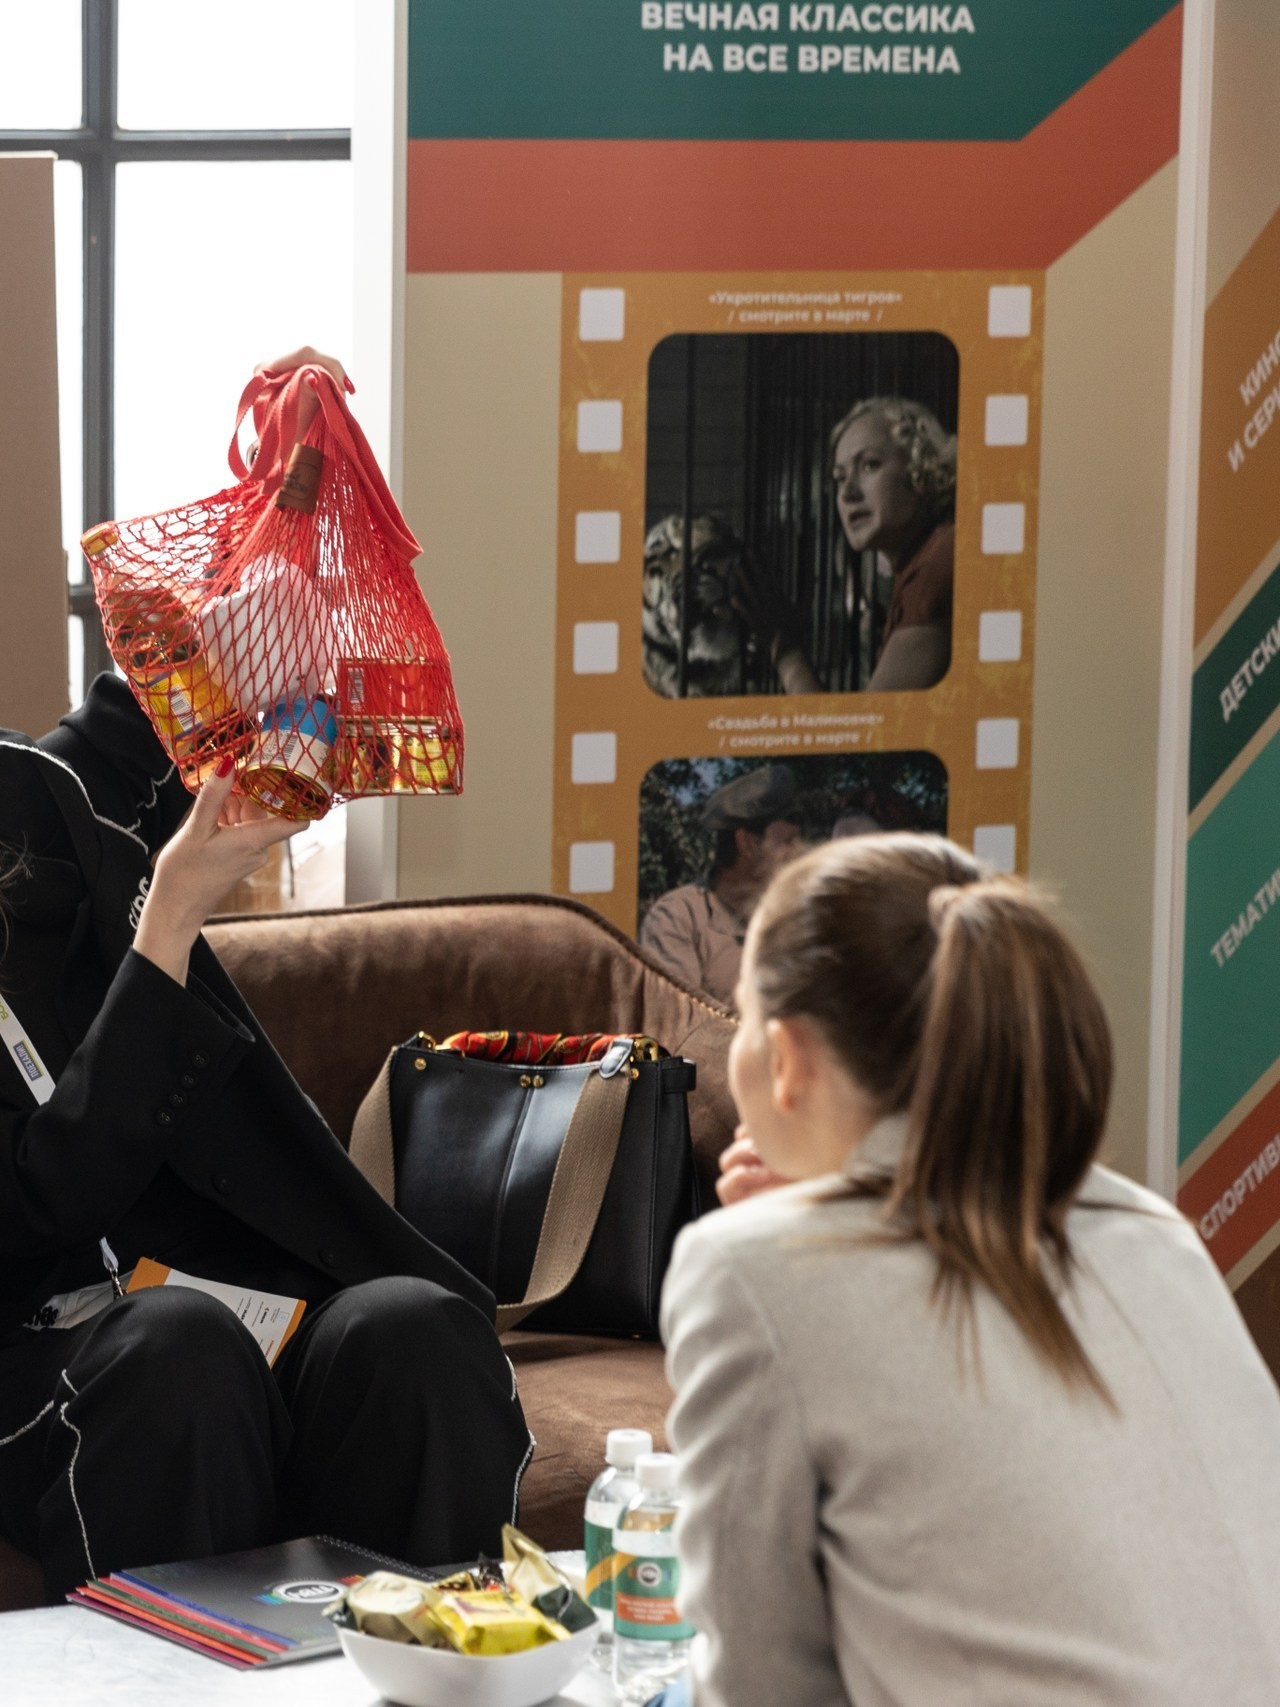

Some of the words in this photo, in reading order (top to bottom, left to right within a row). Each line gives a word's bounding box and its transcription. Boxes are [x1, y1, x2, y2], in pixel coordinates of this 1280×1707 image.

[641, 2, 780, 31] ВЕЧНАЯ
[789, 3, 976, 33] КЛАССИКА
[663, 43, 713, 71] НА
[723, 44, 788, 72] ВСЕ
[798, 45, 961, 73] ВРЕМЕНА
[738, 310, 809, 325] смотрите
[813, 311, 822, 323] в
[826, 311, 870, 324] марте
[1228, 439, 1245, 472] И
[780, 716, 789, 727] в
[729, 733, 800, 749] смотрите
[803, 733, 812, 745] в
[815, 732, 860, 746] марте
